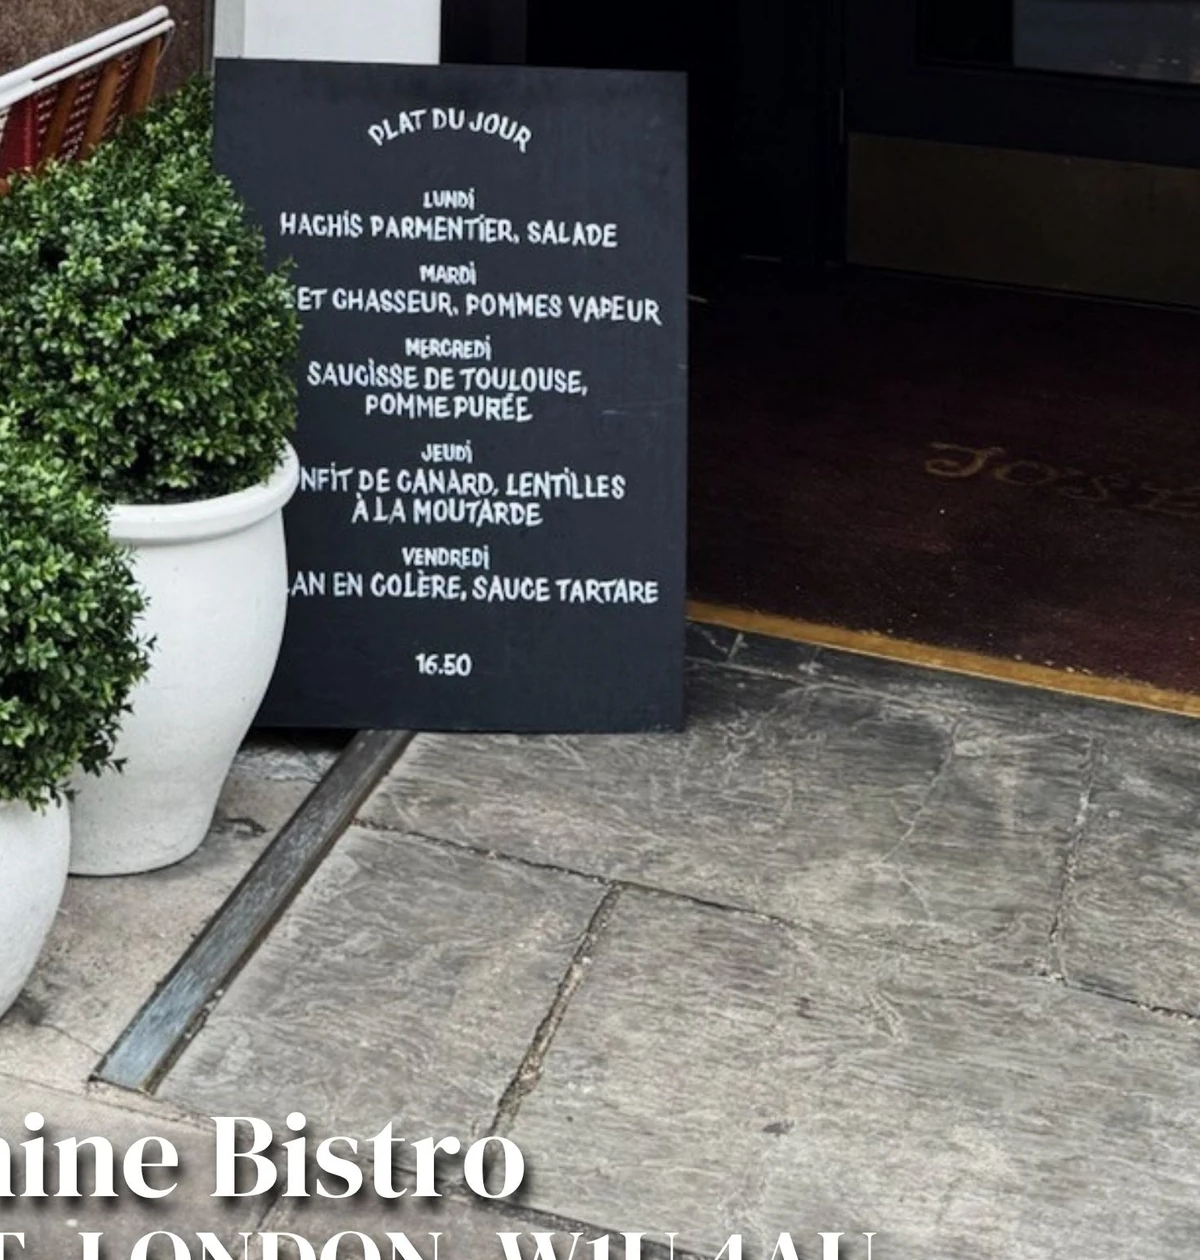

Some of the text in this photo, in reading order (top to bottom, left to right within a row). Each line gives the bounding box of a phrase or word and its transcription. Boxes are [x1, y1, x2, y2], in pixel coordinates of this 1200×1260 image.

[367, 107, 532, 153] PLAT DU JOUR
[526, 219, 618, 248] SALADE
[332, 287, 460, 317] CHASSEUR,
[465, 291, 563, 319] POMMES
[567, 294, 663, 326] VAPEUR
[423, 366, 456, 391] DE
[460, 367, 589, 397] TOULOUSE,
[365, 393, 534, 422] POMME PURÉE
[300, 461, 354, 492] NFIT
[357, 468, 391, 493] DE
[396, 468, 499, 497] CANARD,
[351, 491, 544, 528] À LA MOUTARDE
[333, 571, 363, 598] EN
[369, 569, 469, 602] COLÈRE,
[471, 574, 550, 603] SAUCE
[554, 577, 659, 605] TARTARE
[415, 652, 473, 677] 16.50
